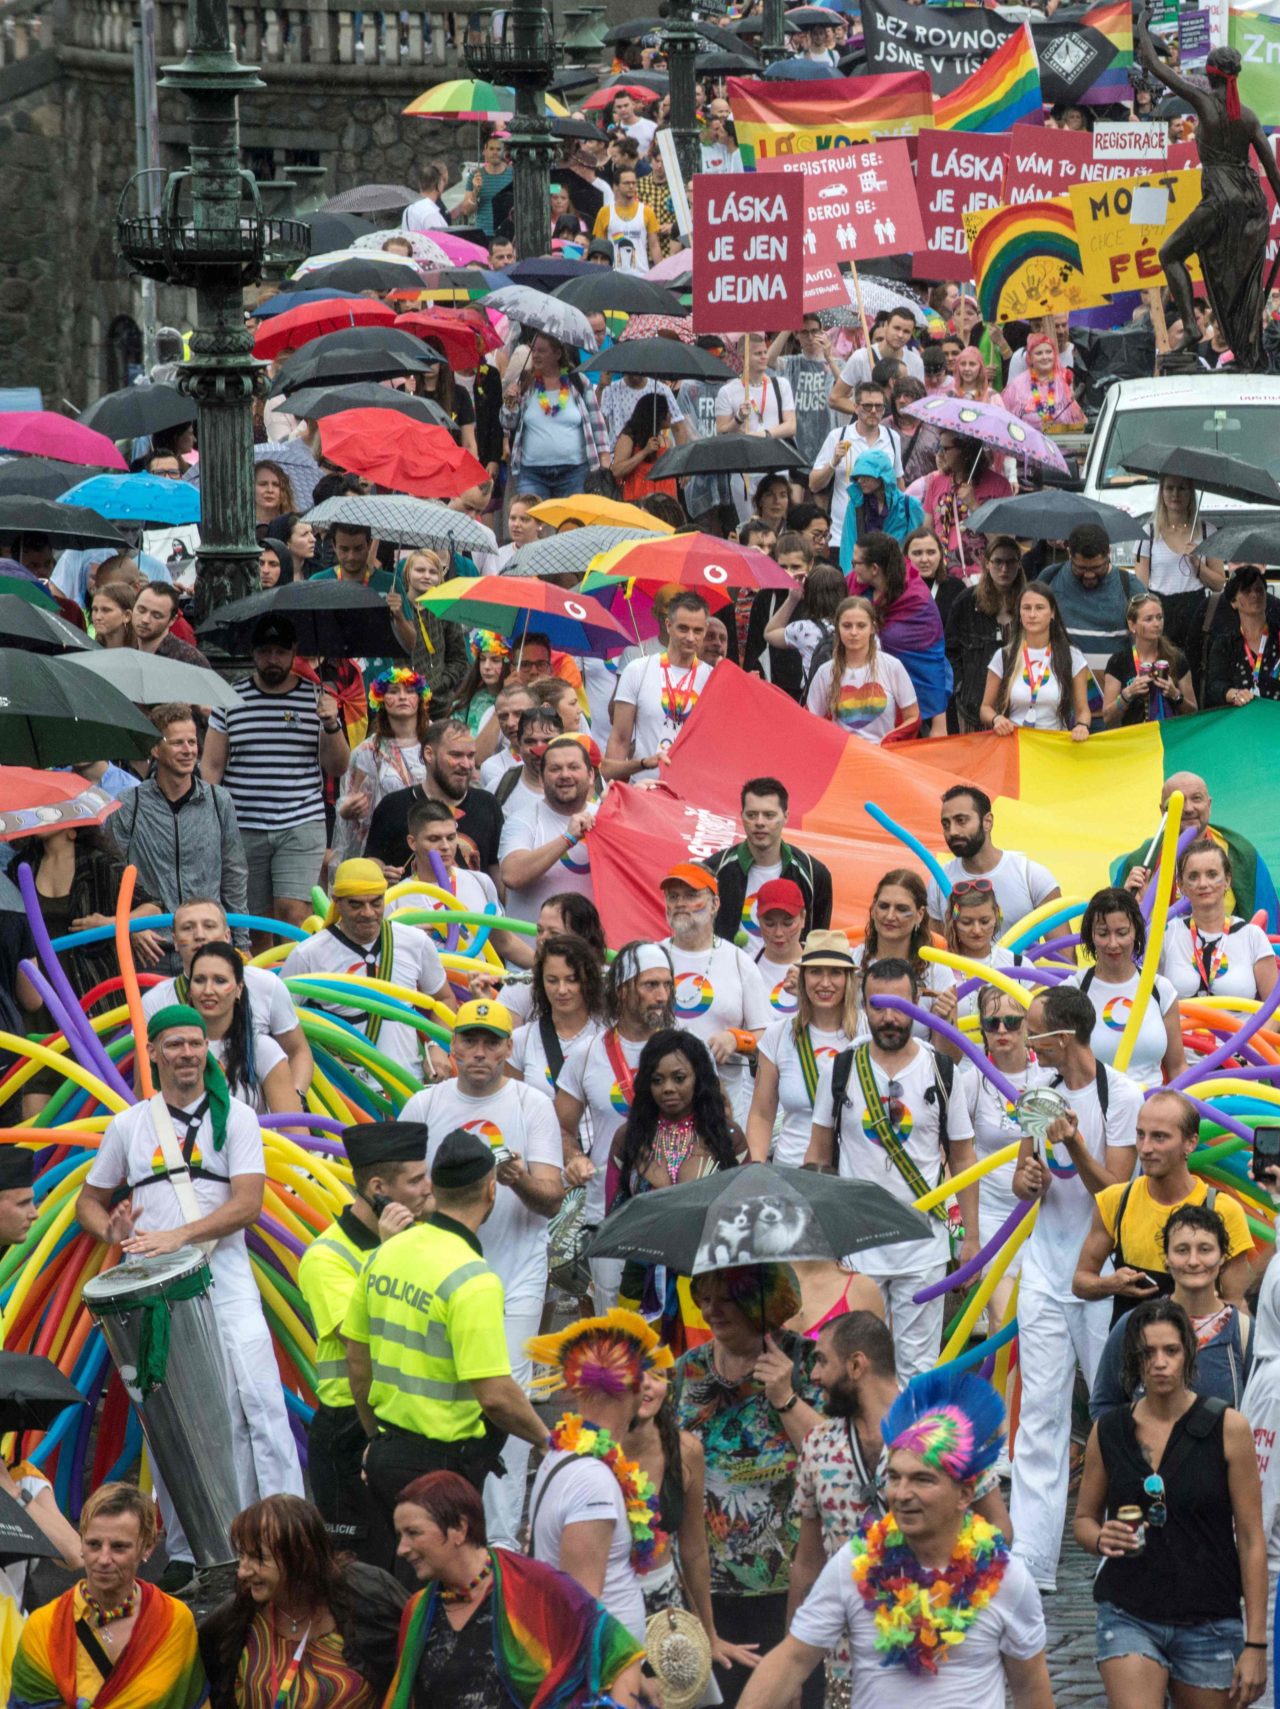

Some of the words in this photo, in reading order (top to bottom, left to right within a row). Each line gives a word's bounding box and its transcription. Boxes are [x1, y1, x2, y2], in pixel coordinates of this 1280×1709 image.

[875, 12, 907, 40] BEZ
[914, 24, 1013, 50] ROVNOS
[874, 41, 924, 68] JSME
[929, 57, 947, 74] V
[953, 52, 989, 75] TÍS
[1094, 131, 1166, 150] REGISTRACE
[861, 152, 884, 168] SE:
[931, 148, 1003, 182] LÁSKA
[1016, 152, 1053, 177] VÁM
[1059, 159, 1076, 176] TO
[708, 190, 789, 225] LÁSKA
[808, 202, 850, 222] BEROU
[855, 200, 877, 216] SE:
[929, 189, 955, 213] JE
[963, 191, 1002, 213] JEN
[1089, 176, 1179, 221] MOT
[708, 235, 735, 263] JE
[743, 235, 789, 263] JEN
[928, 226, 968, 254] JED
[1109, 237, 1163, 284] FÉ
[707, 272, 789, 303] JEDNA
[799, 371, 825, 391] FREE
[698, 397, 716, 416] FR
[795, 391, 826, 411] HUGS
[367, 1273, 434, 1315] POLICIE
[323, 1522, 357, 1535] OLICIE
